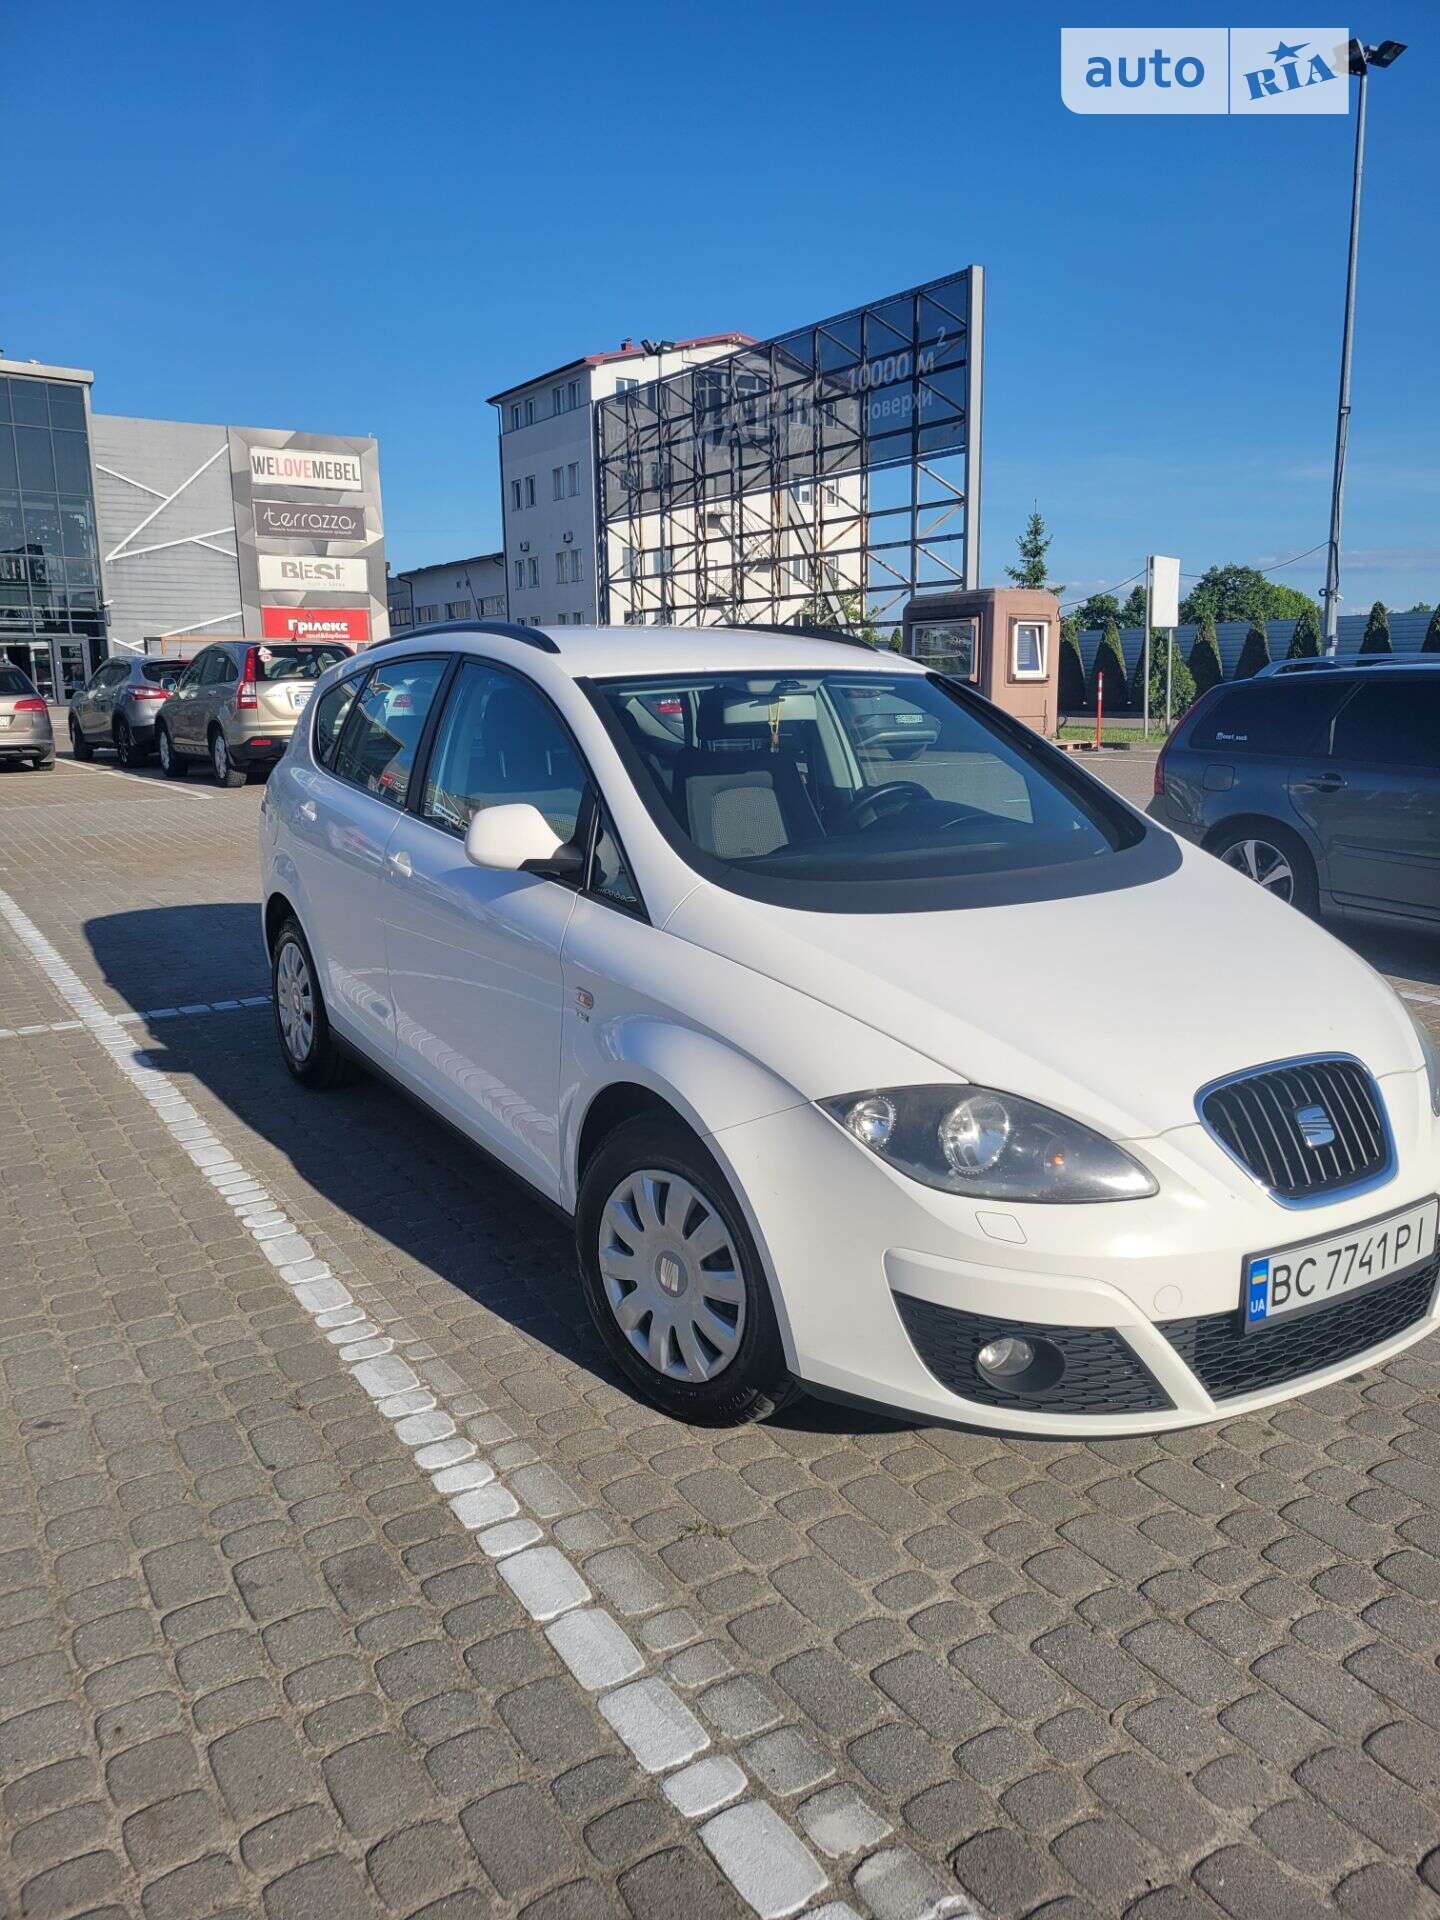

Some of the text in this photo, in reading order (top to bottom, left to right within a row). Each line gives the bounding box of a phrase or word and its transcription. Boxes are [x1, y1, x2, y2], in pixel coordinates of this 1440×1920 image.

[251, 455, 360, 481] WELOVEMEBEL
[264, 507, 356, 530] terrazza
[1251, 1299, 1266, 1313] UA
